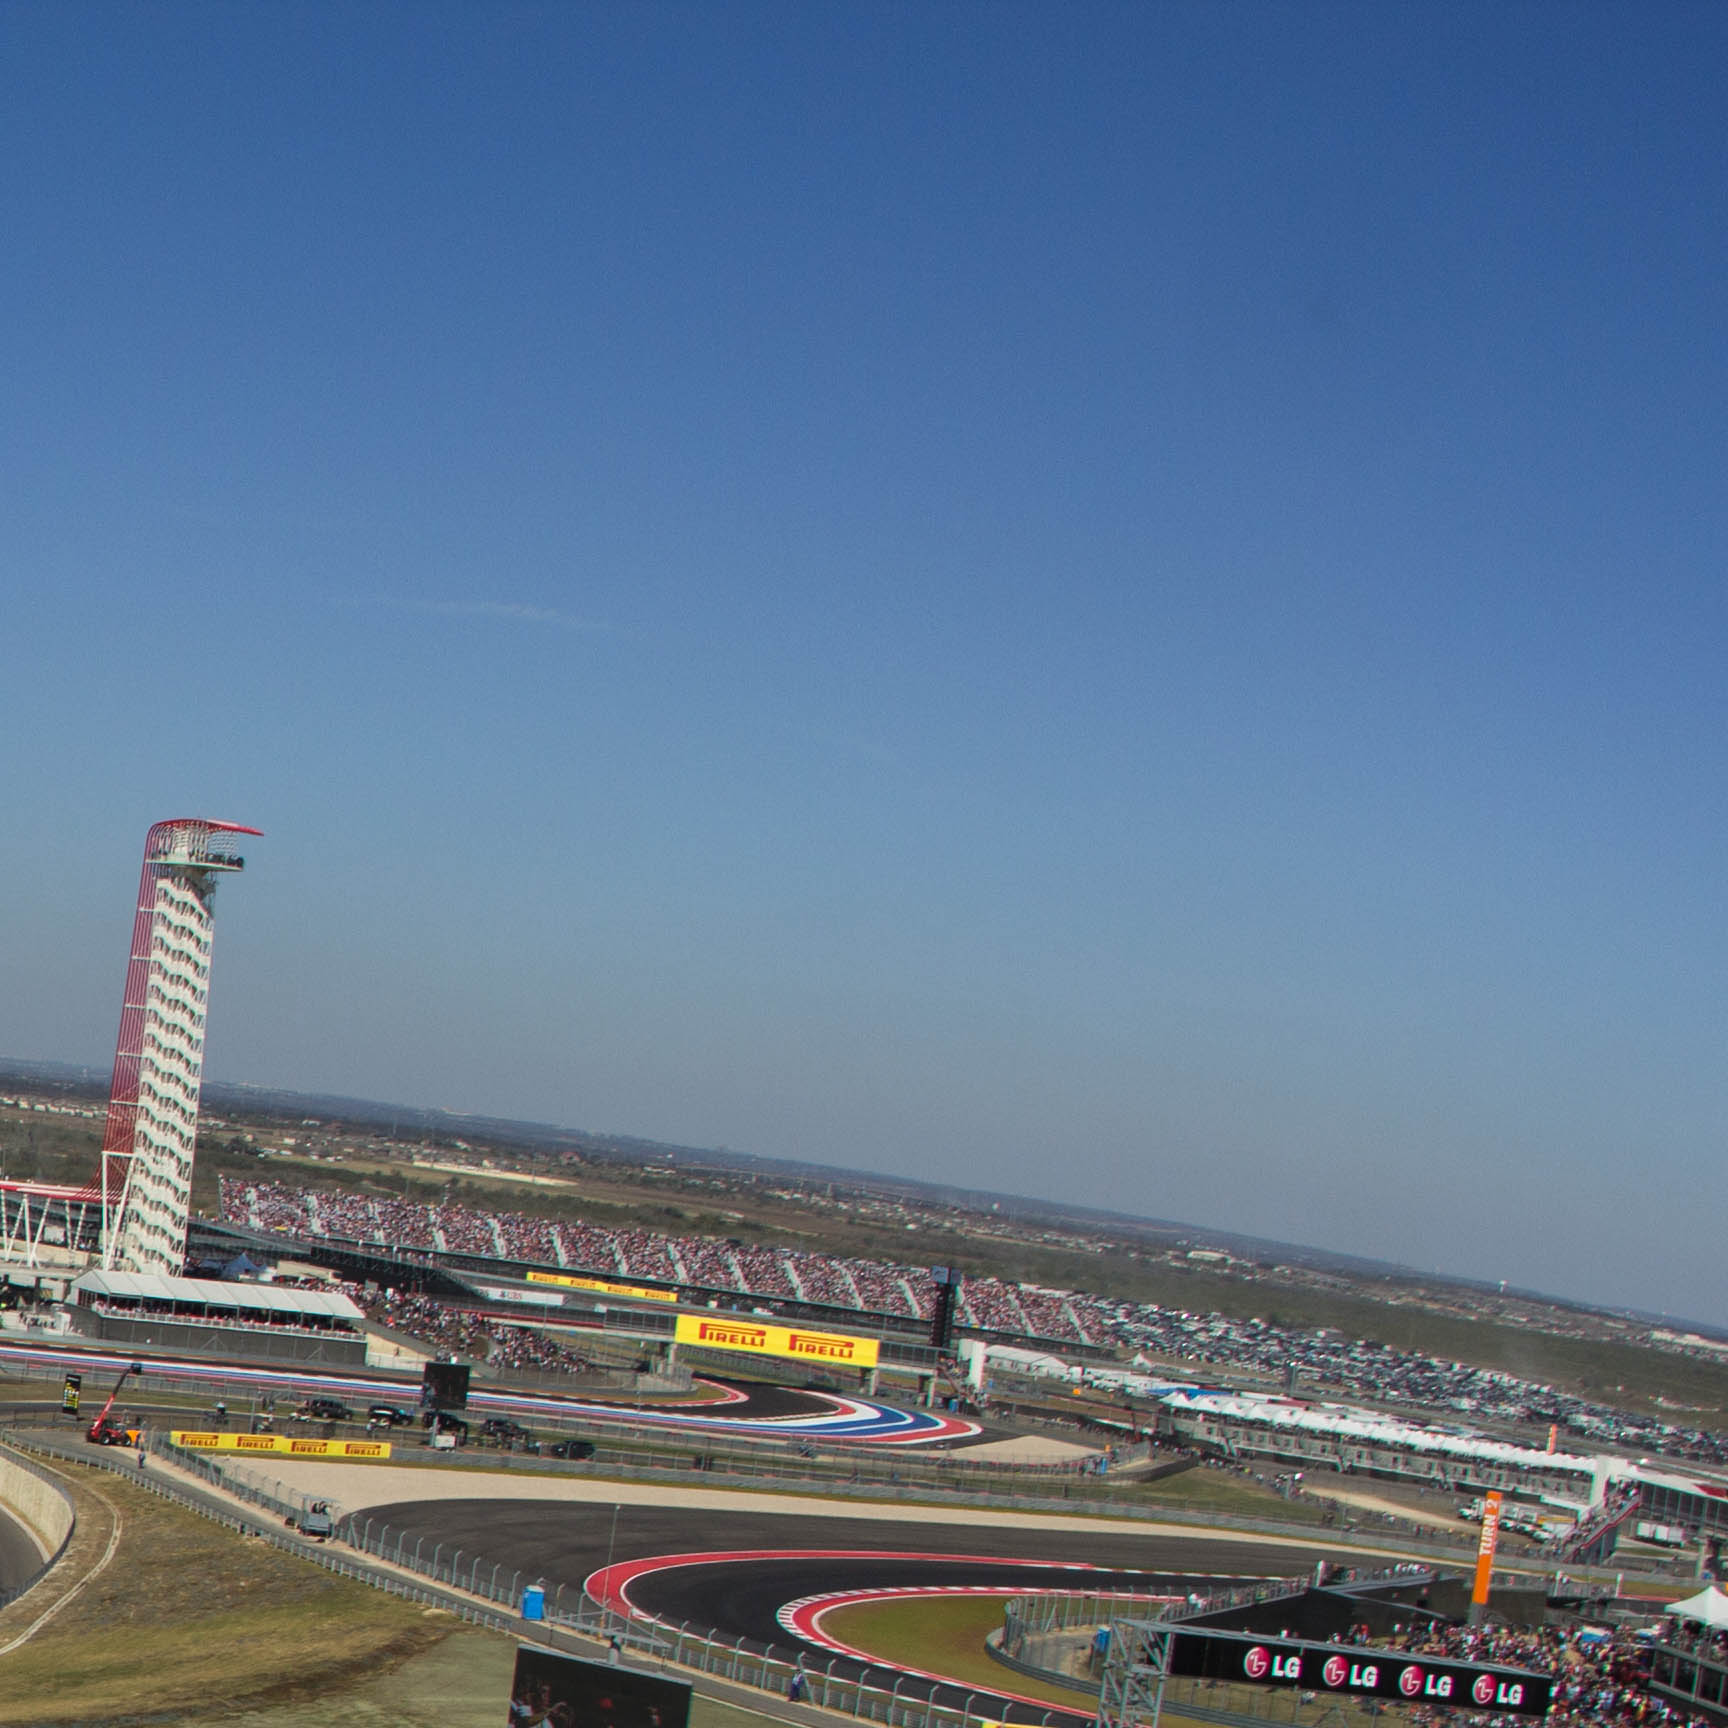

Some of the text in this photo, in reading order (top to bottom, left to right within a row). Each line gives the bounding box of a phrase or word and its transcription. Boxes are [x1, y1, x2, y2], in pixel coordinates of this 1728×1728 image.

[699, 1323, 855, 1358] PIRELLI PIRELLI
[180, 1433, 219, 1447] PIRELLI
[236, 1436, 274, 1449] PIRELLI
[291, 1440, 328, 1454] PIRELLI
[345, 1443, 381, 1456] PIRELLI
[1479, 1499, 1497, 1556] TURN 2
[1271, 1655, 1524, 1706] LG LG LG LG
